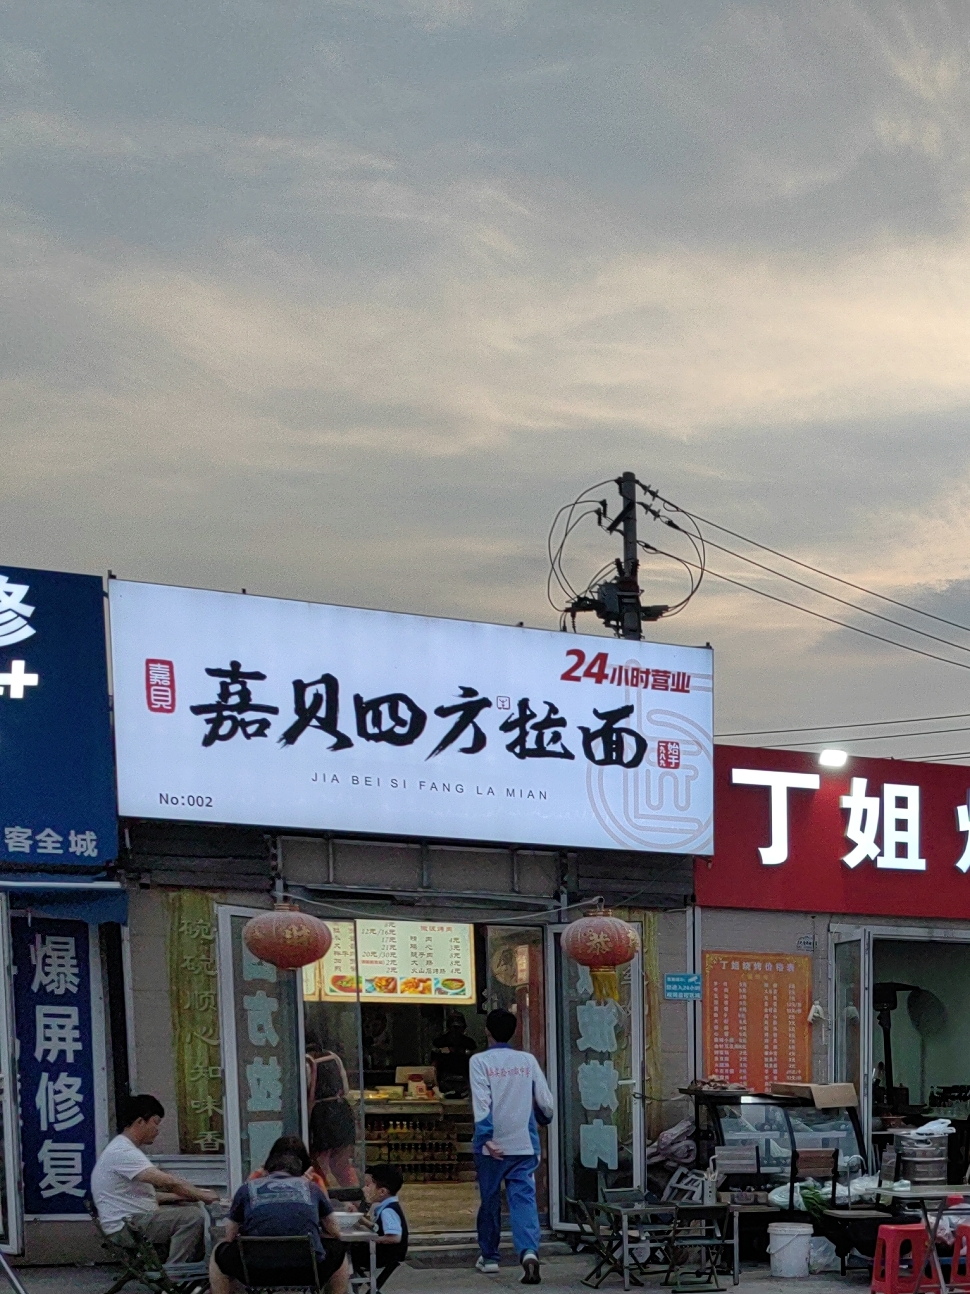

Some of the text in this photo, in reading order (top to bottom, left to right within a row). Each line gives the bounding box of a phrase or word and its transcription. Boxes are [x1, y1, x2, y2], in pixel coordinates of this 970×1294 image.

[560, 648, 691, 694] 24小时营业
[189, 660, 648, 769] 嘉贝四方拉面
[158, 792, 214, 808] No:002
[311, 772, 548, 800] JIA BEI SI FANG LA MIAN
[4, 826, 99, 858] 客全城
[30, 933, 88, 1199] 爆屏修复
